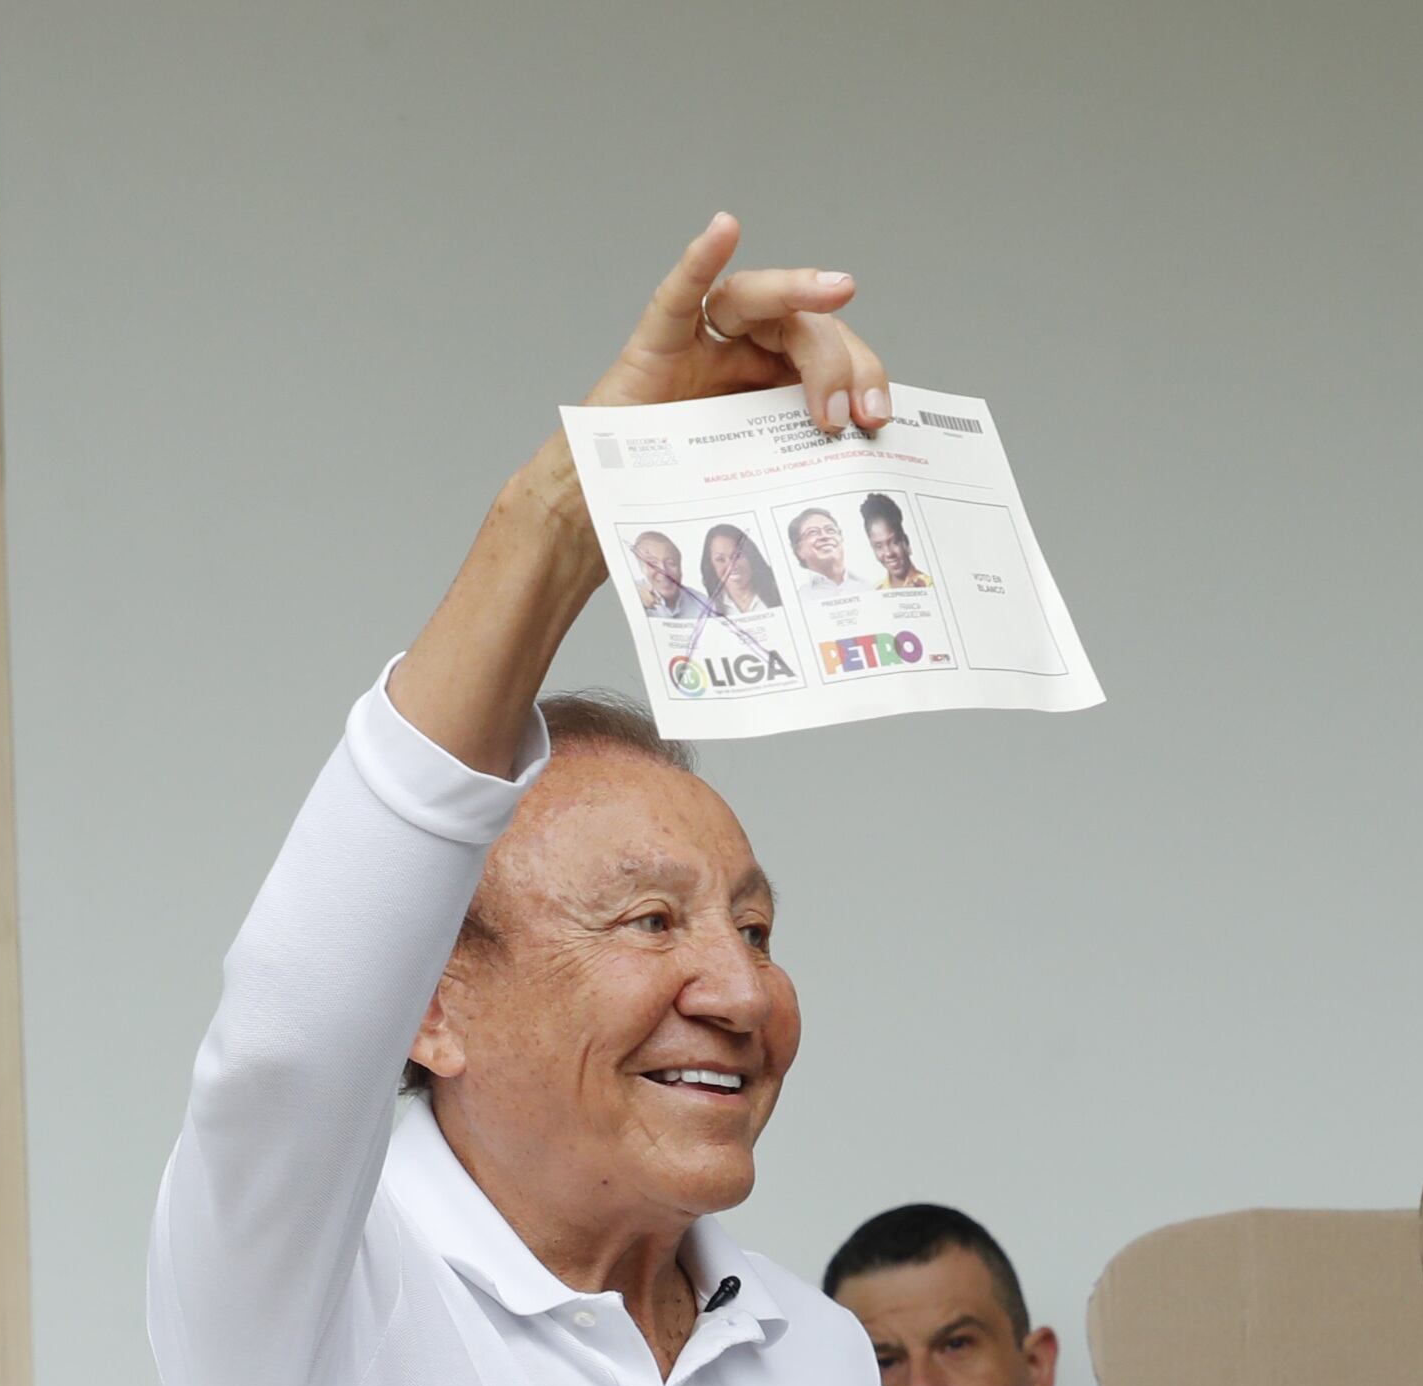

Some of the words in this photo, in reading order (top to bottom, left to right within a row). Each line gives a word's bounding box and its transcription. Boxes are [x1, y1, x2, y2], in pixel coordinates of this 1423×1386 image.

[746, 414, 776, 426] VOTO
[778, 409, 801, 421] POR
[688, 430, 754, 445] PRESIDENTE
[756, 428, 764, 436] Y
[767, 418, 814, 434] VICEPRE
[779, 436, 833, 454] SEGUNDA
[818, 630, 925, 676] PETRO
[705, 650, 796, 687] LIGA
